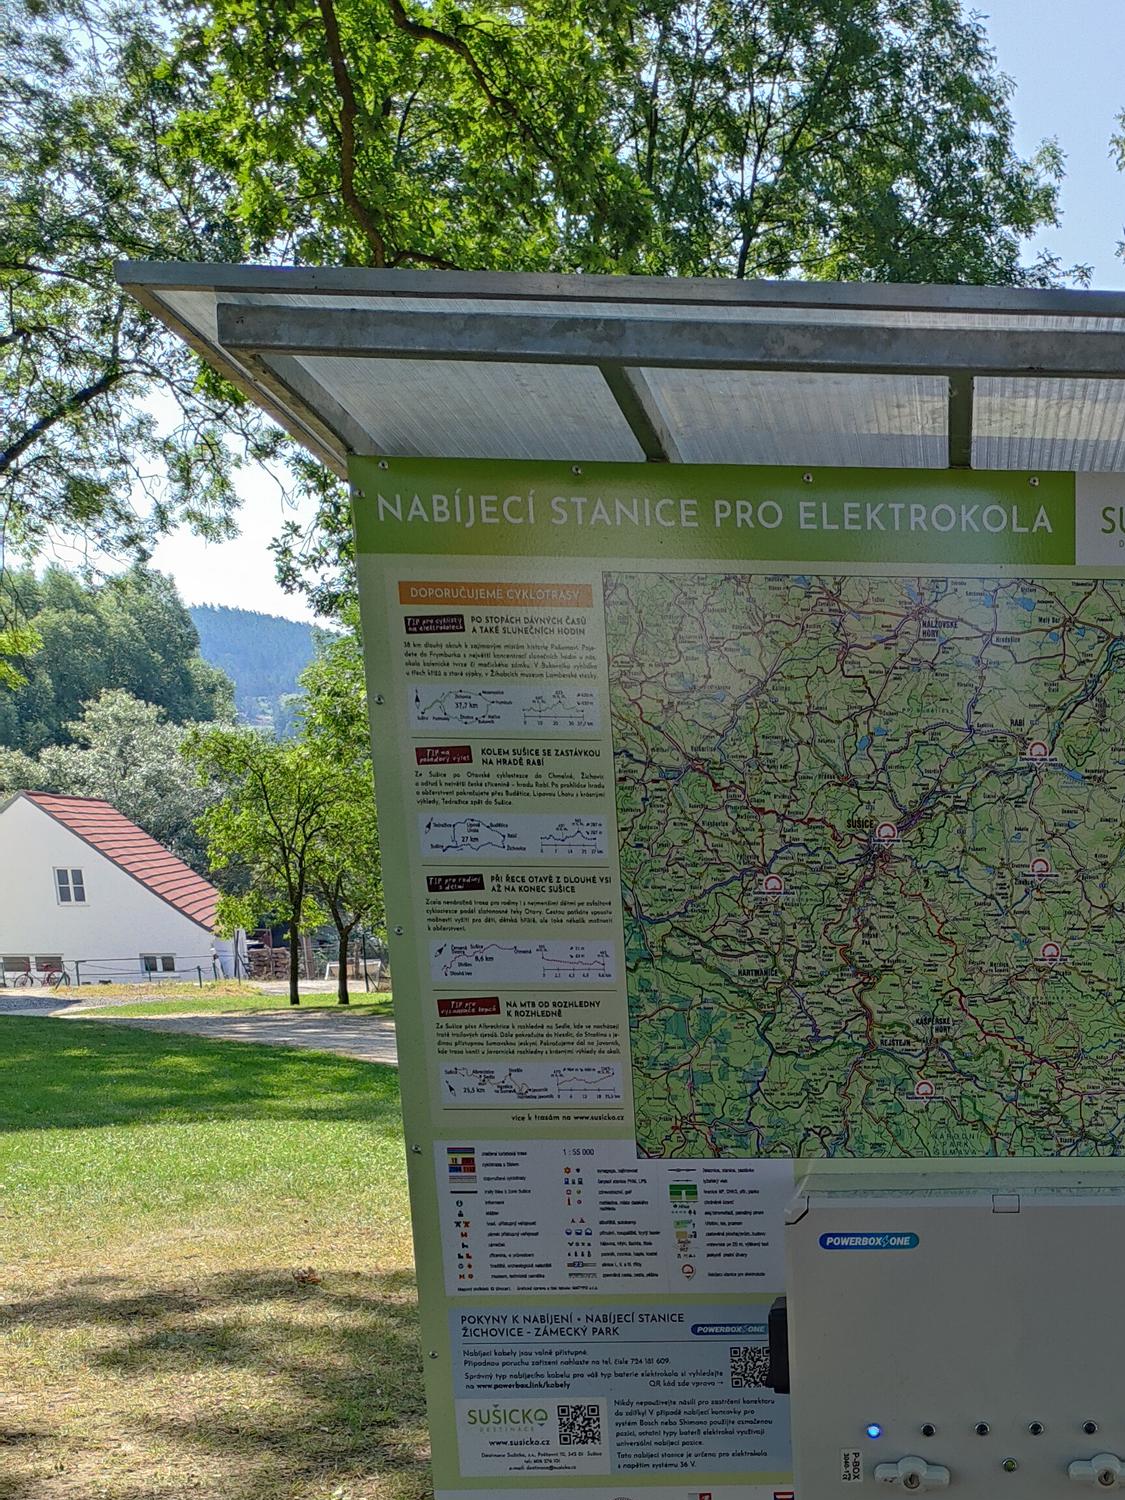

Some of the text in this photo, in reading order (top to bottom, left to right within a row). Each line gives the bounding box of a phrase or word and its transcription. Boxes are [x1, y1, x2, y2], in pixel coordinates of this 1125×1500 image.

[377, 493, 1052, 532] NABÍJECÍ STANICE PRO ELEKTROKOLA
[410, 587, 578, 600] DOPORUČUJEME CYKLOTRASY
[484, 615, 521, 624] STOPÁCH
[523, 615, 562, 624] DÁVNÝCH
[565, 615, 586, 625] ČASŮ
[479, 625, 498, 633] TAKÉ
[502, 625, 554, 634] SLUNEČNÍCH
[481, 747, 509, 755] KOLEM
[512, 747, 539, 757] SUŠICE
[554, 748, 600, 757] ZASTÁVKOU
[496, 756, 523, 765] HRADĚ
[526, 757, 544, 766] RABÍ
[846, 818, 874, 828] SUŠICE
[490, 873, 502, 884] PŘI
[505, 874, 525, 883] ŘECE
[528, 874, 553, 883] OTAVĚ
[555, 876, 561, 885] Z
[563, 875, 596, 883] DLOUHÉ
[490, 884, 501, 892] AŽ
[548, 884, 575, 893] SUŠICE
[552, 1000, 600, 1009] ROZHLEDNY
[514, 1009, 561, 1017] ROZHLEDNĚ
[826, 1237, 910, 1246] POWERBOX ONE
[460, 1311, 684, 1325] POKYNY K NABÍJENÍ NABÍJECÍ STANICE
[461, 1325, 619, 1337] ŽICHOVICE ZÁMECKÝ PARK
[467, 1404, 548, 1426] SUŠICKO
